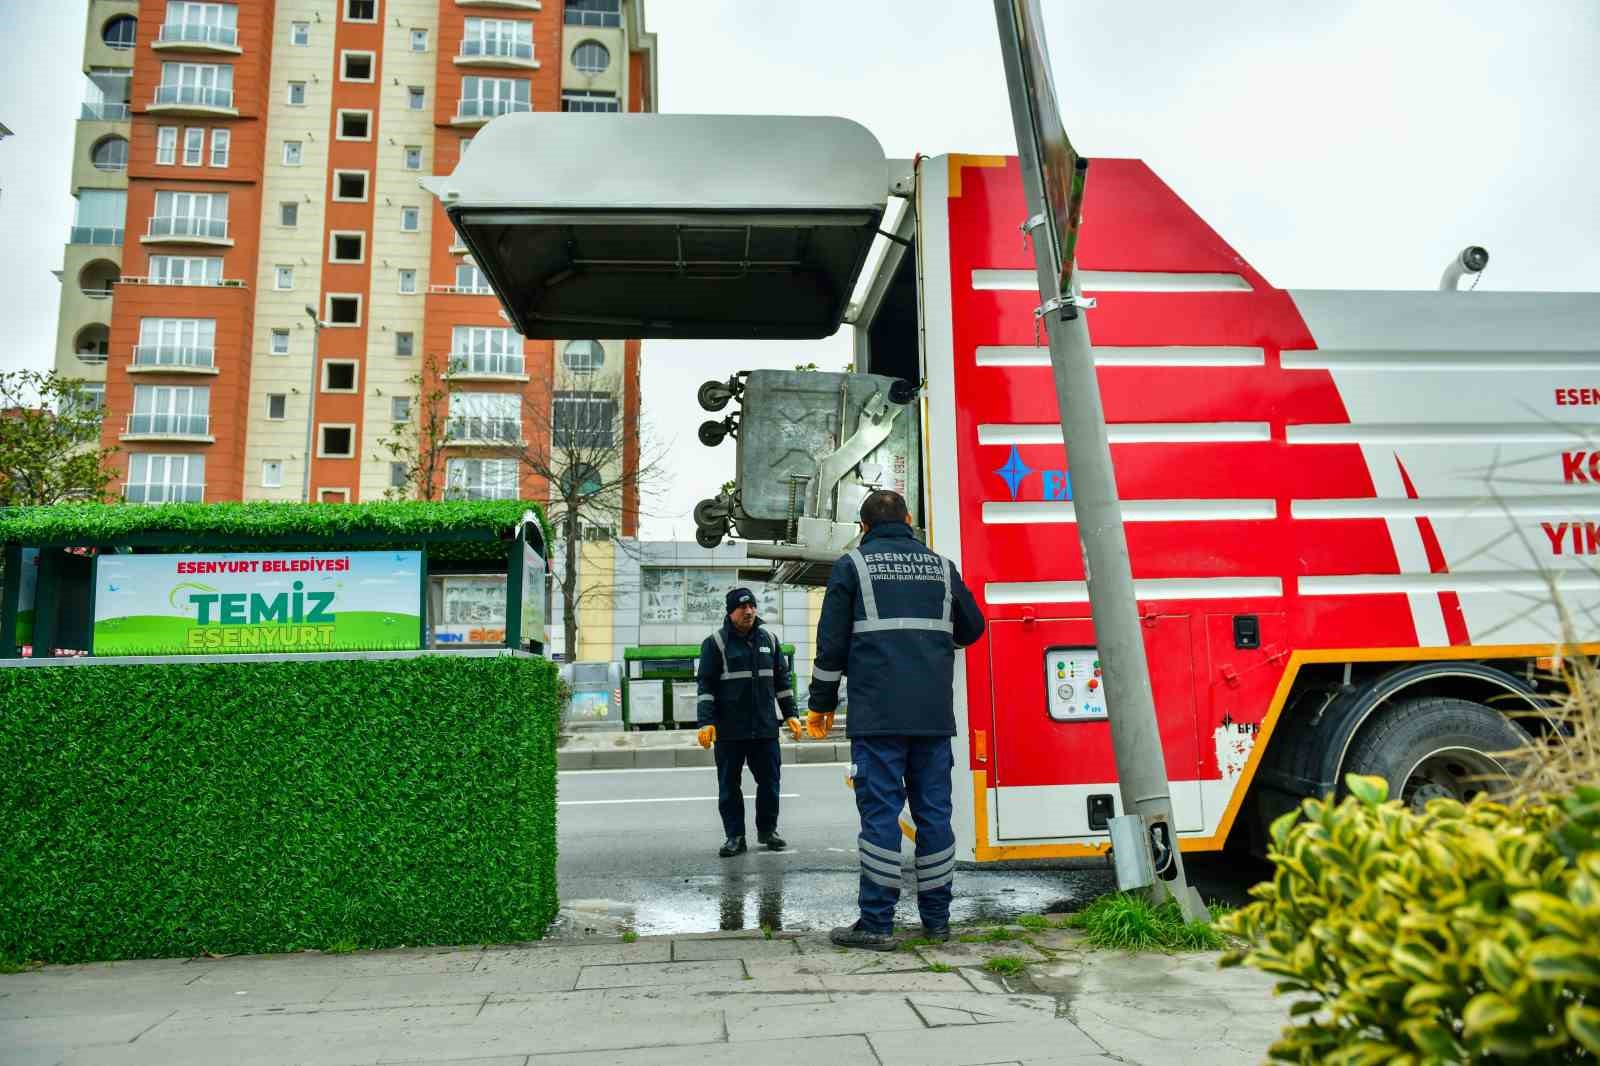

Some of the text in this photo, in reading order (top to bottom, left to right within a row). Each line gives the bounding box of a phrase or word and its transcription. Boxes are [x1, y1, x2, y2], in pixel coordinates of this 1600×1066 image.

[177, 556, 350, 574] ESENYURT BELEDİYESİ
[864, 552, 939, 564] ESENYURT
[189, 580, 336, 626] TEMİZ
[187, 625, 336, 648] ESENYURT
